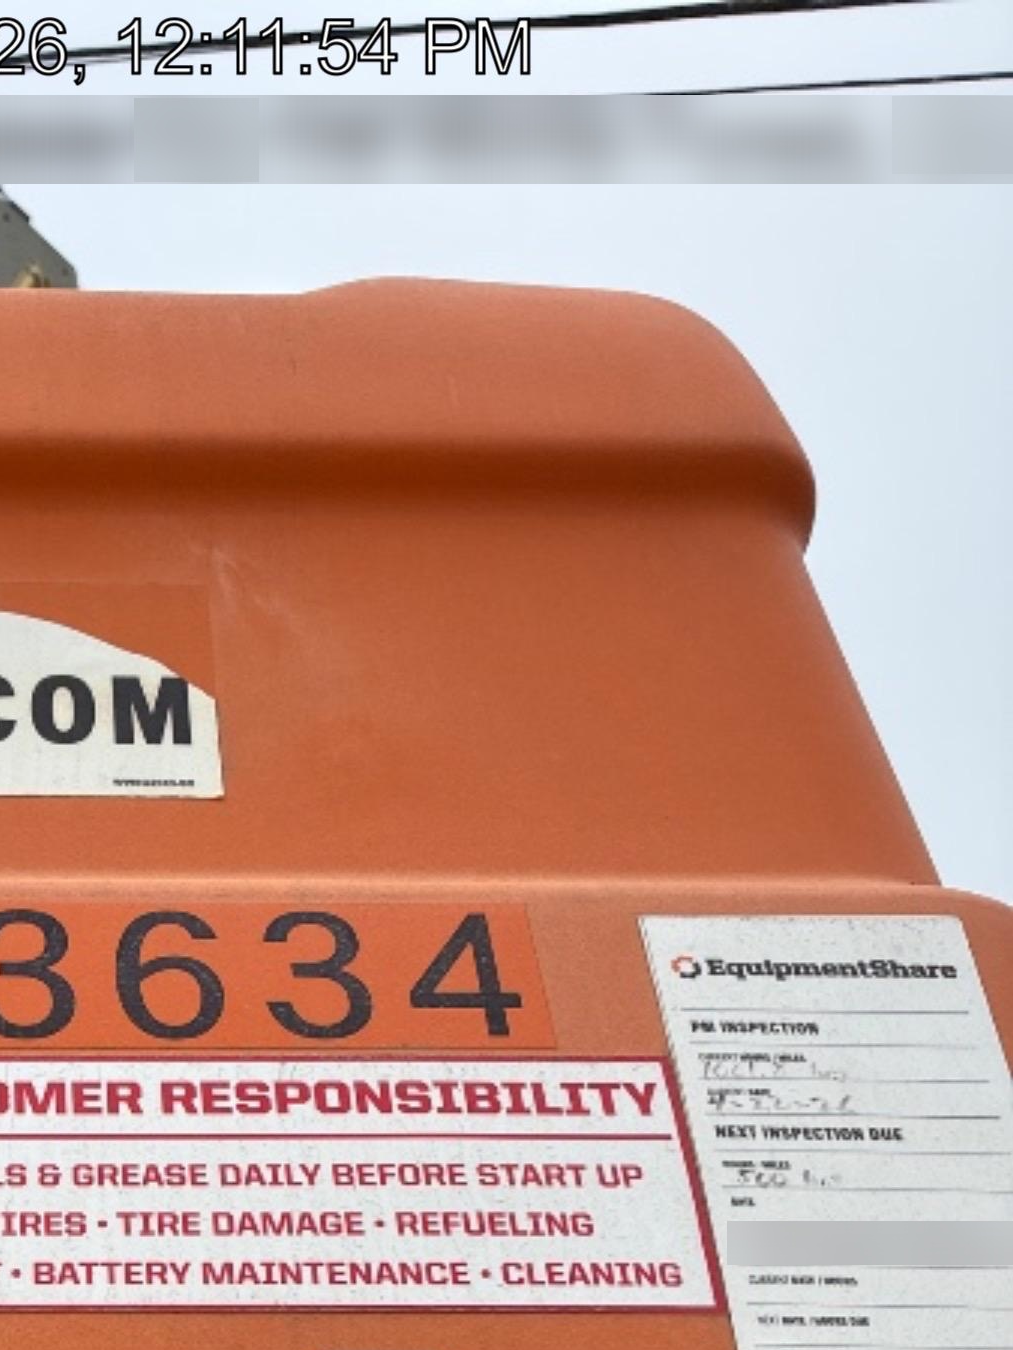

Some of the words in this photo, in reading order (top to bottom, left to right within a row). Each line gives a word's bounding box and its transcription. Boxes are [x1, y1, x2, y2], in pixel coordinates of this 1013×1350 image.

[705, 958, 957, 981] EquipmentShare
[719, 1022, 820, 1035] INSPECTION
[160, 1080, 657, 1117] RESPONSIBILITY
[715, 1124, 756, 1139] NEXT
[762, 1125, 864, 1141] INSPECTION
[869, 1127, 903, 1141] DUE
[38, 1163, 61, 1187] &
[73, 1163, 208, 1187] GREASE
[220, 1163, 321, 1187] DAILY
[332, 1163, 468, 1187] BEFORE
[478, 1163, 586, 1187] START
[596, 1164, 643, 1188] UP
[117, 1211, 201, 1236] TIRE
[212, 1211, 365, 1236] DAMAGE
[396, 1211, 594, 1237] REFUELING
[35, 1261, 188, 1286] BATTERY
[202, 1261, 470, 1286] MAINTENANCE
[503, 1262, 683, 1286] CLEANING
